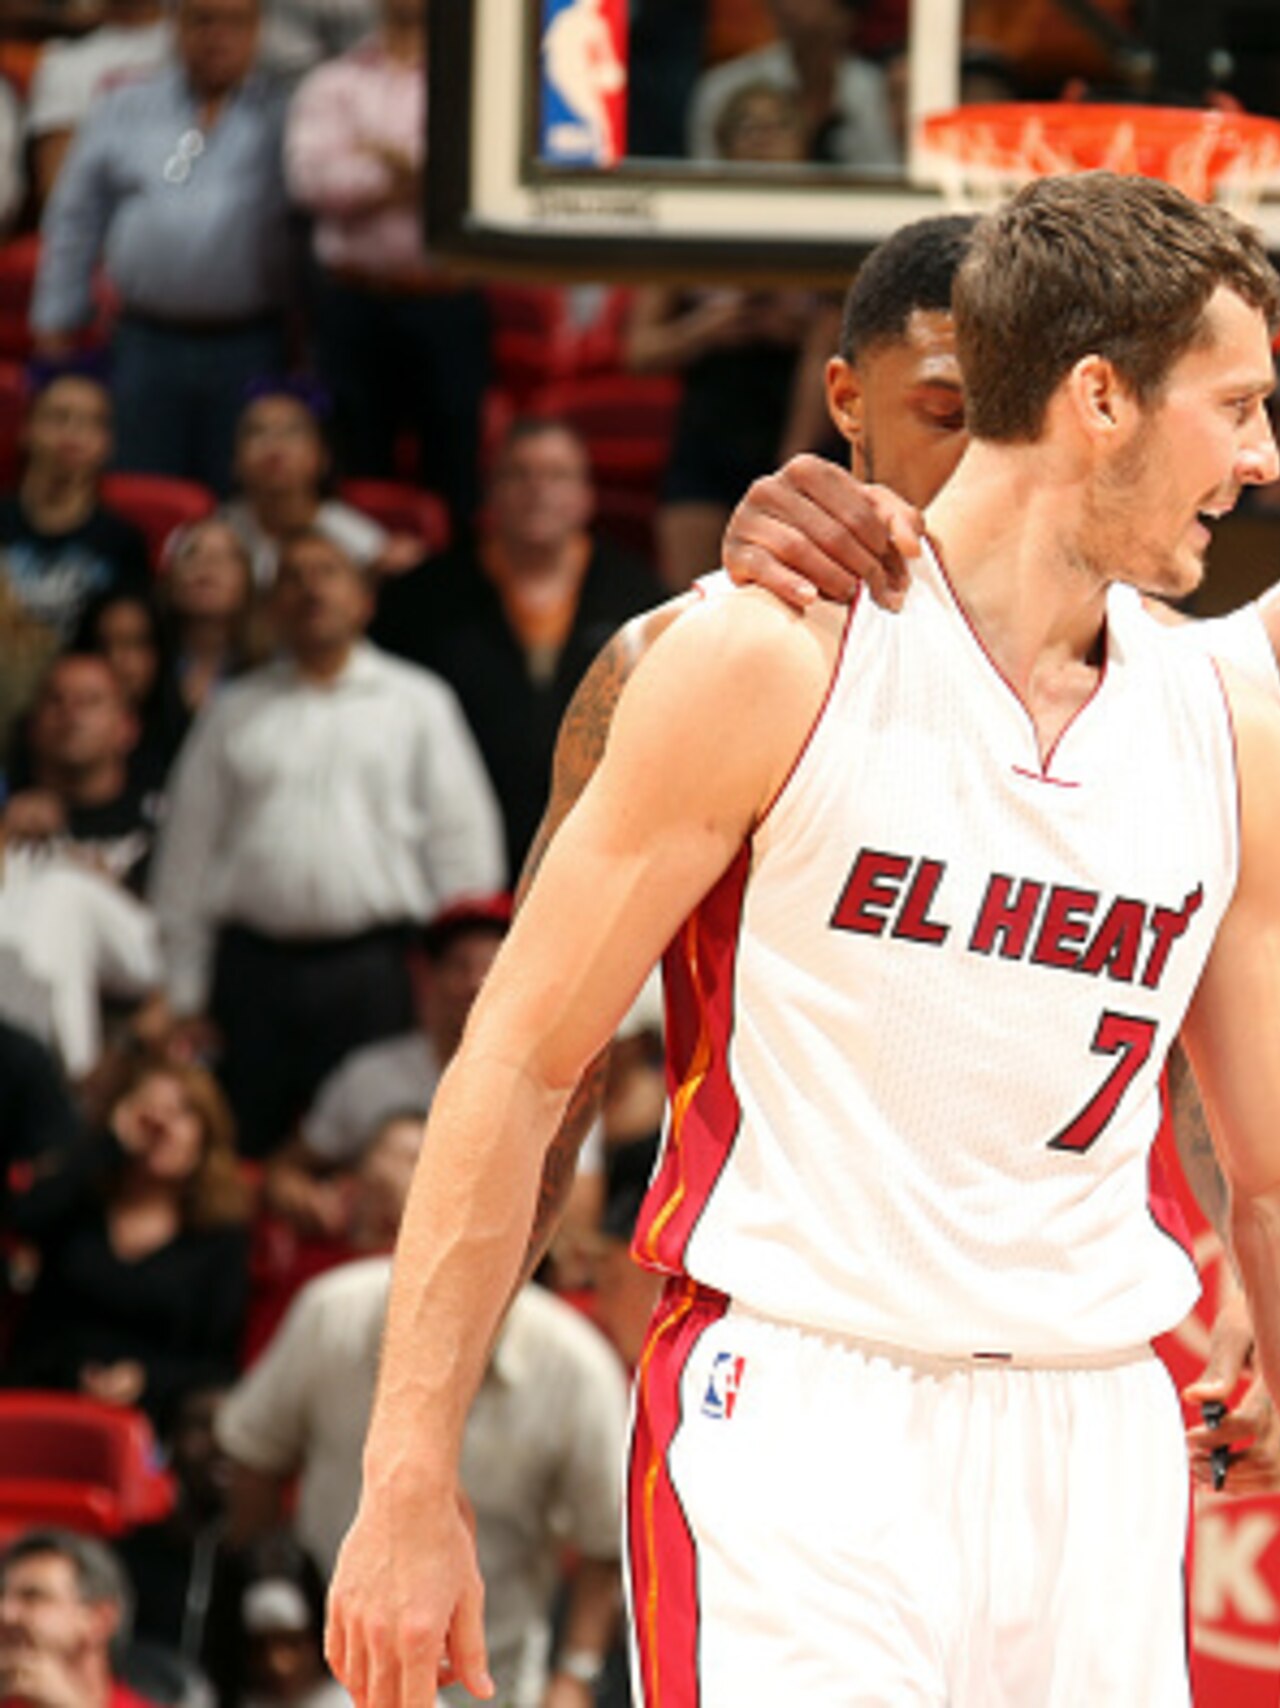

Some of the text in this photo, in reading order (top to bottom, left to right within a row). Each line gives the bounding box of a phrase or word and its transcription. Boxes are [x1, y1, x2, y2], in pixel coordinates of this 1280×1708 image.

[829, 848, 1205, 990] EL HEAT
[1046, 1009, 1160, 1154] 7
